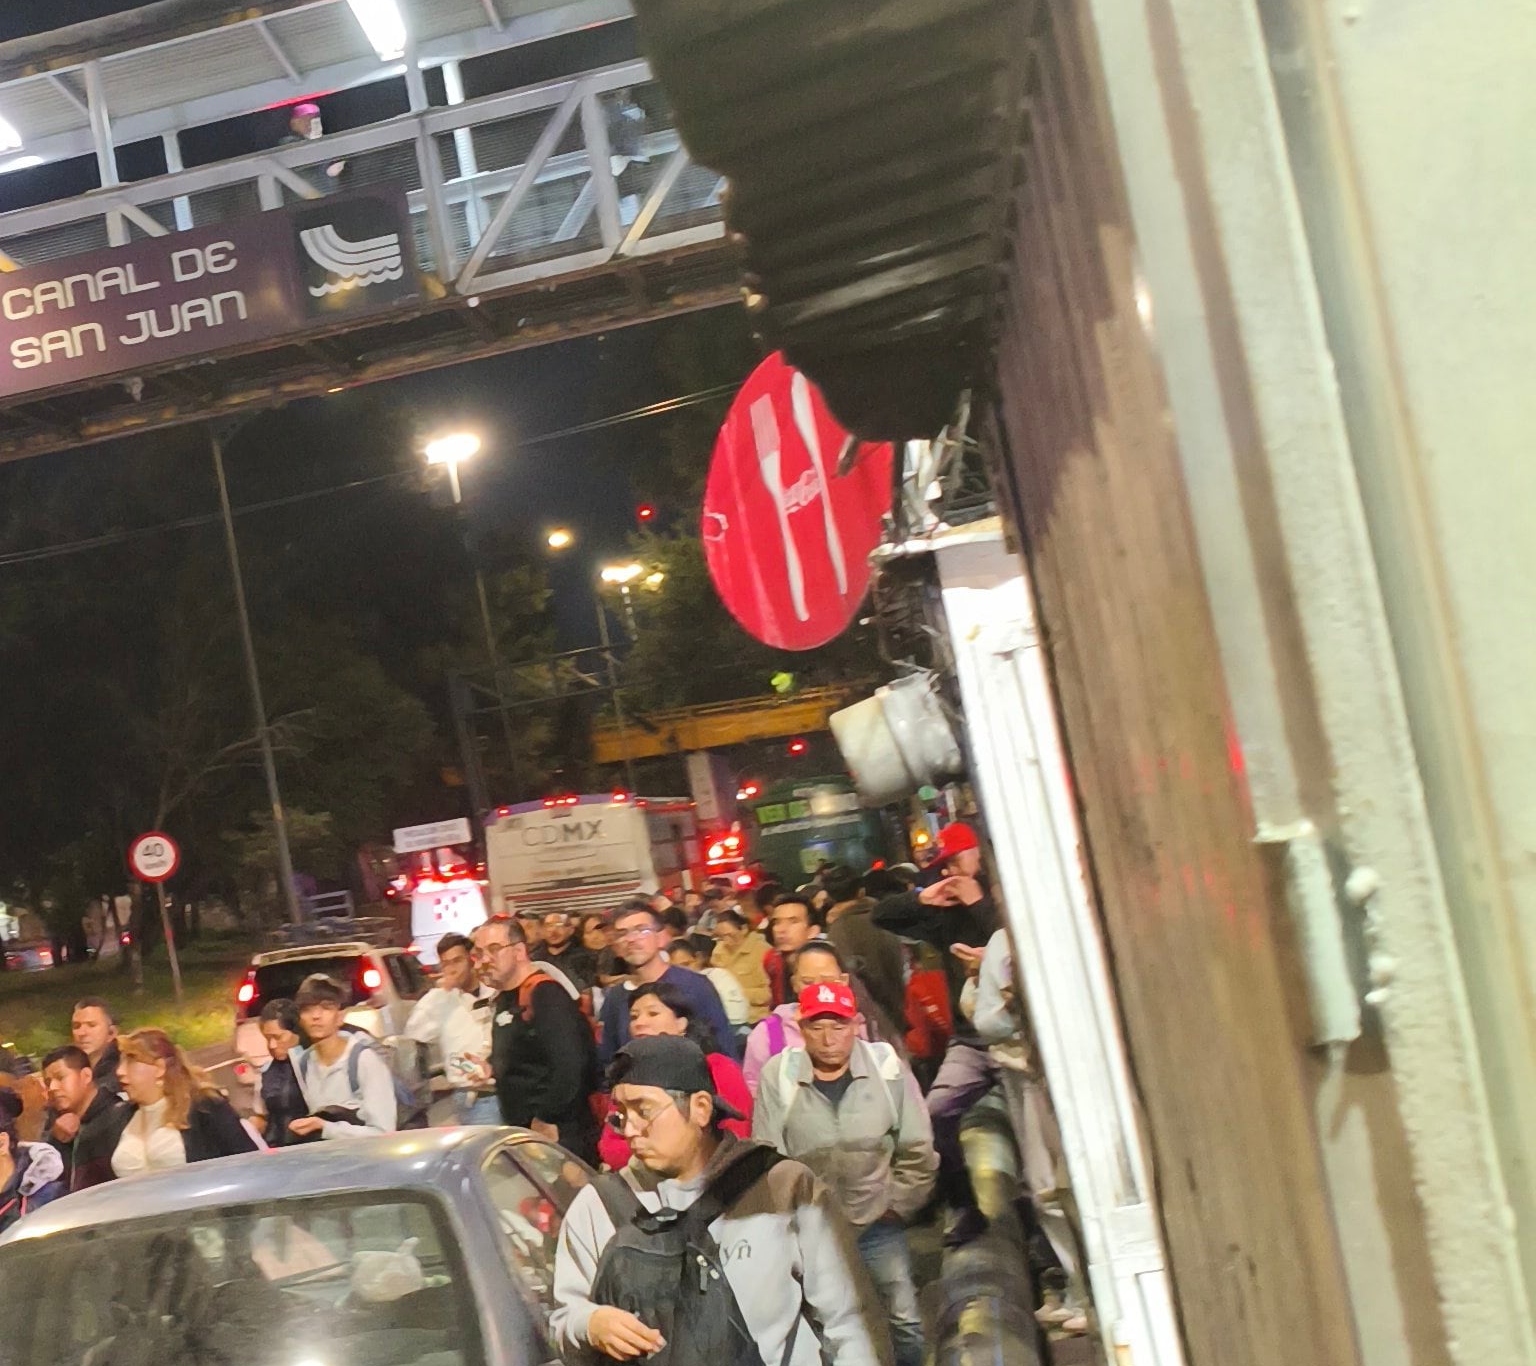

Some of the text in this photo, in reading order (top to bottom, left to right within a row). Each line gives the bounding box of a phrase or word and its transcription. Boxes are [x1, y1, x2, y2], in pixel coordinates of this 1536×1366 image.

[1, 240, 238, 320] CANAL DE
[10, 290, 247, 369] SAN JUAN
[143, 842, 165, 857] 40
[521, 819, 604, 847] CDMX
